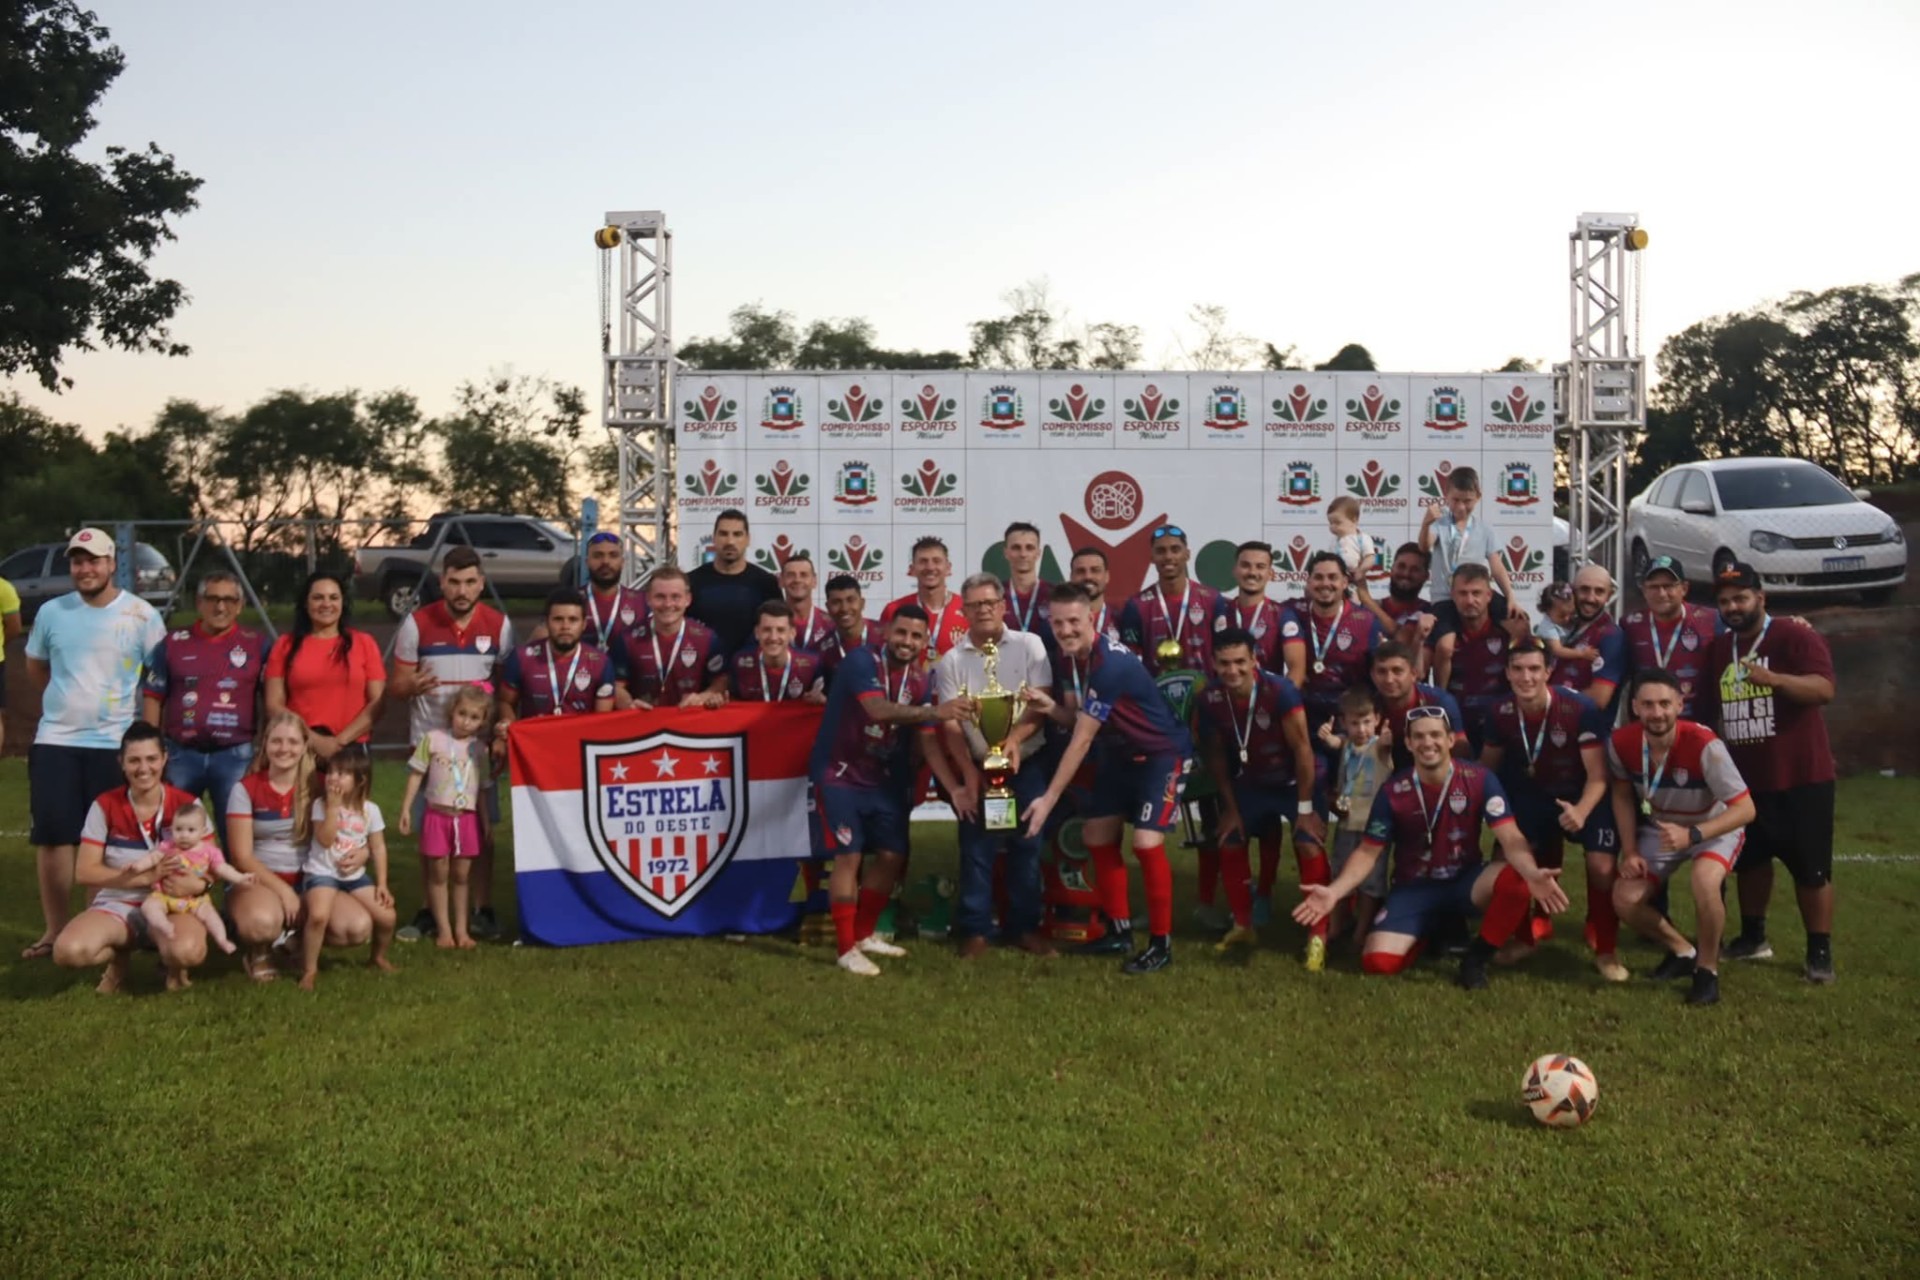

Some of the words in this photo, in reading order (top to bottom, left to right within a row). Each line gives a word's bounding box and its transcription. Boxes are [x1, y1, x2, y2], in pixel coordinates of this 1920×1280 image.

[684, 421, 738, 432] ESPORTES
[820, 422, 891, 432] COMPROMISSO
[901, 420, 958, 432] ESPORTES
[1042, 422, 1112, 431] COMPROMISSO
[1123, 420, 1180, 431] ESPORTES
[1265, 422, 1335, 432] COMPROMISSO
[1345, 421, 1401, 432] ESPORTES
[1483, 423, 1553, 432] COMPROMISSO
[678, 497, 745, 507] COMPROMISSO
[755, 496, 811, 507] ESPORTES
[894, 497, 965, 507] COMPROMISSO
[1090, 700, 1102, 717] C
[1721, 699, 1750, 721] NON
[1752, 696, 1775, 718] SI
[606, 779, 726, 818] ESTRELA
[1140, 802, 1153, 822] 8
[624, 820, 645, 835] DO
[655, 816, 711, 833] OESTE
[1598, 828, 1615, 847] 13
[648, 858, 690, 874] 1972
